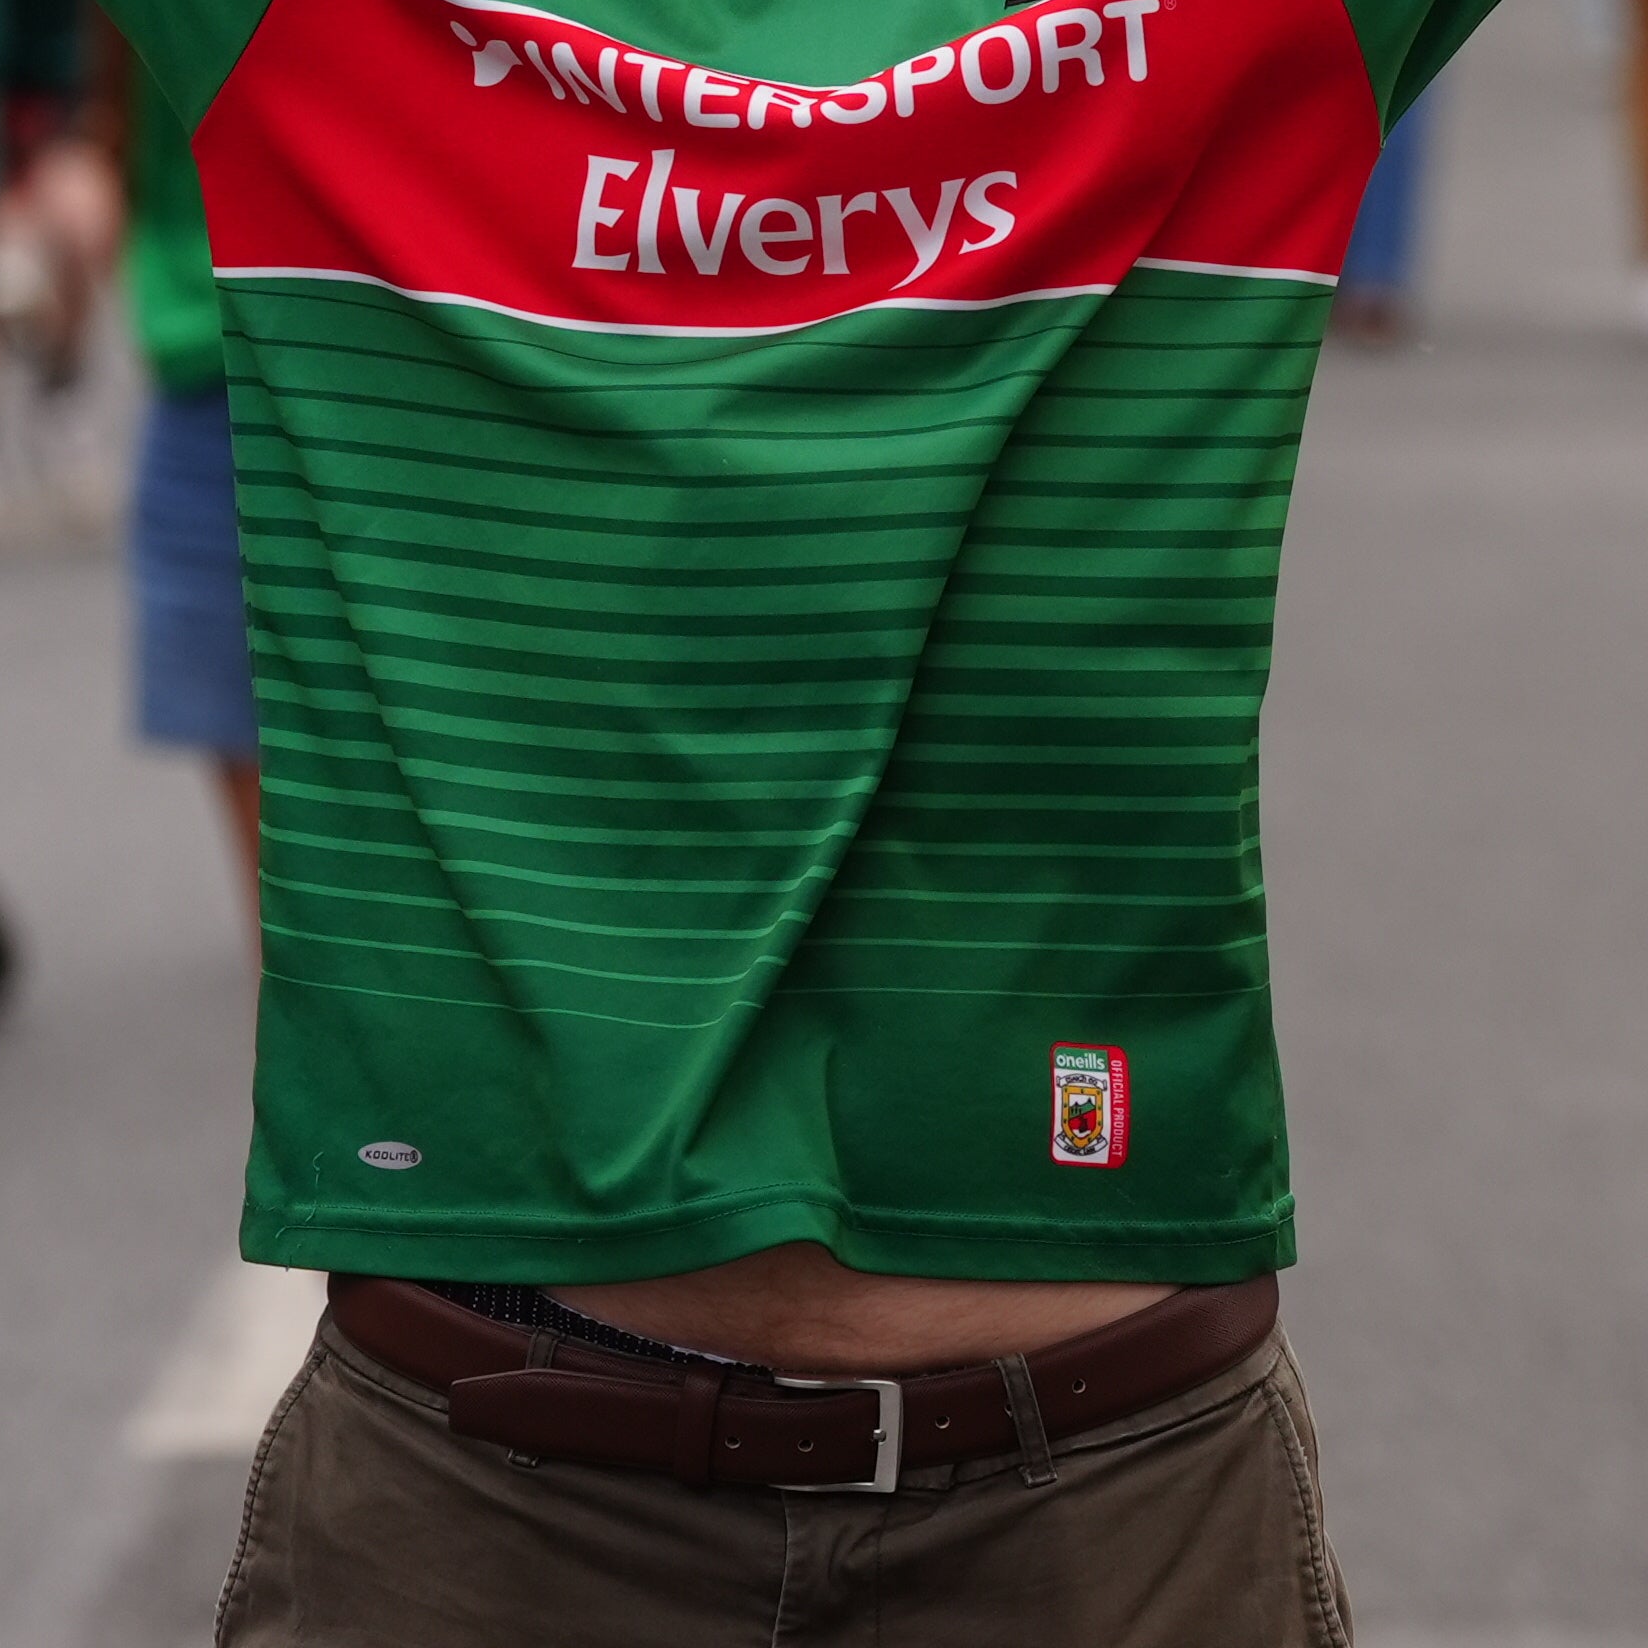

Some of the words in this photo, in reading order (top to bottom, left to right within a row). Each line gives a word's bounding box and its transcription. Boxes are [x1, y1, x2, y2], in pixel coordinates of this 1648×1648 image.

[571, 149, 1018, 290] Elverys
[1111, 1060, 1124, 1104] OFFICIAL
[1112, 1107, 1125, 1157] PRODUCT
